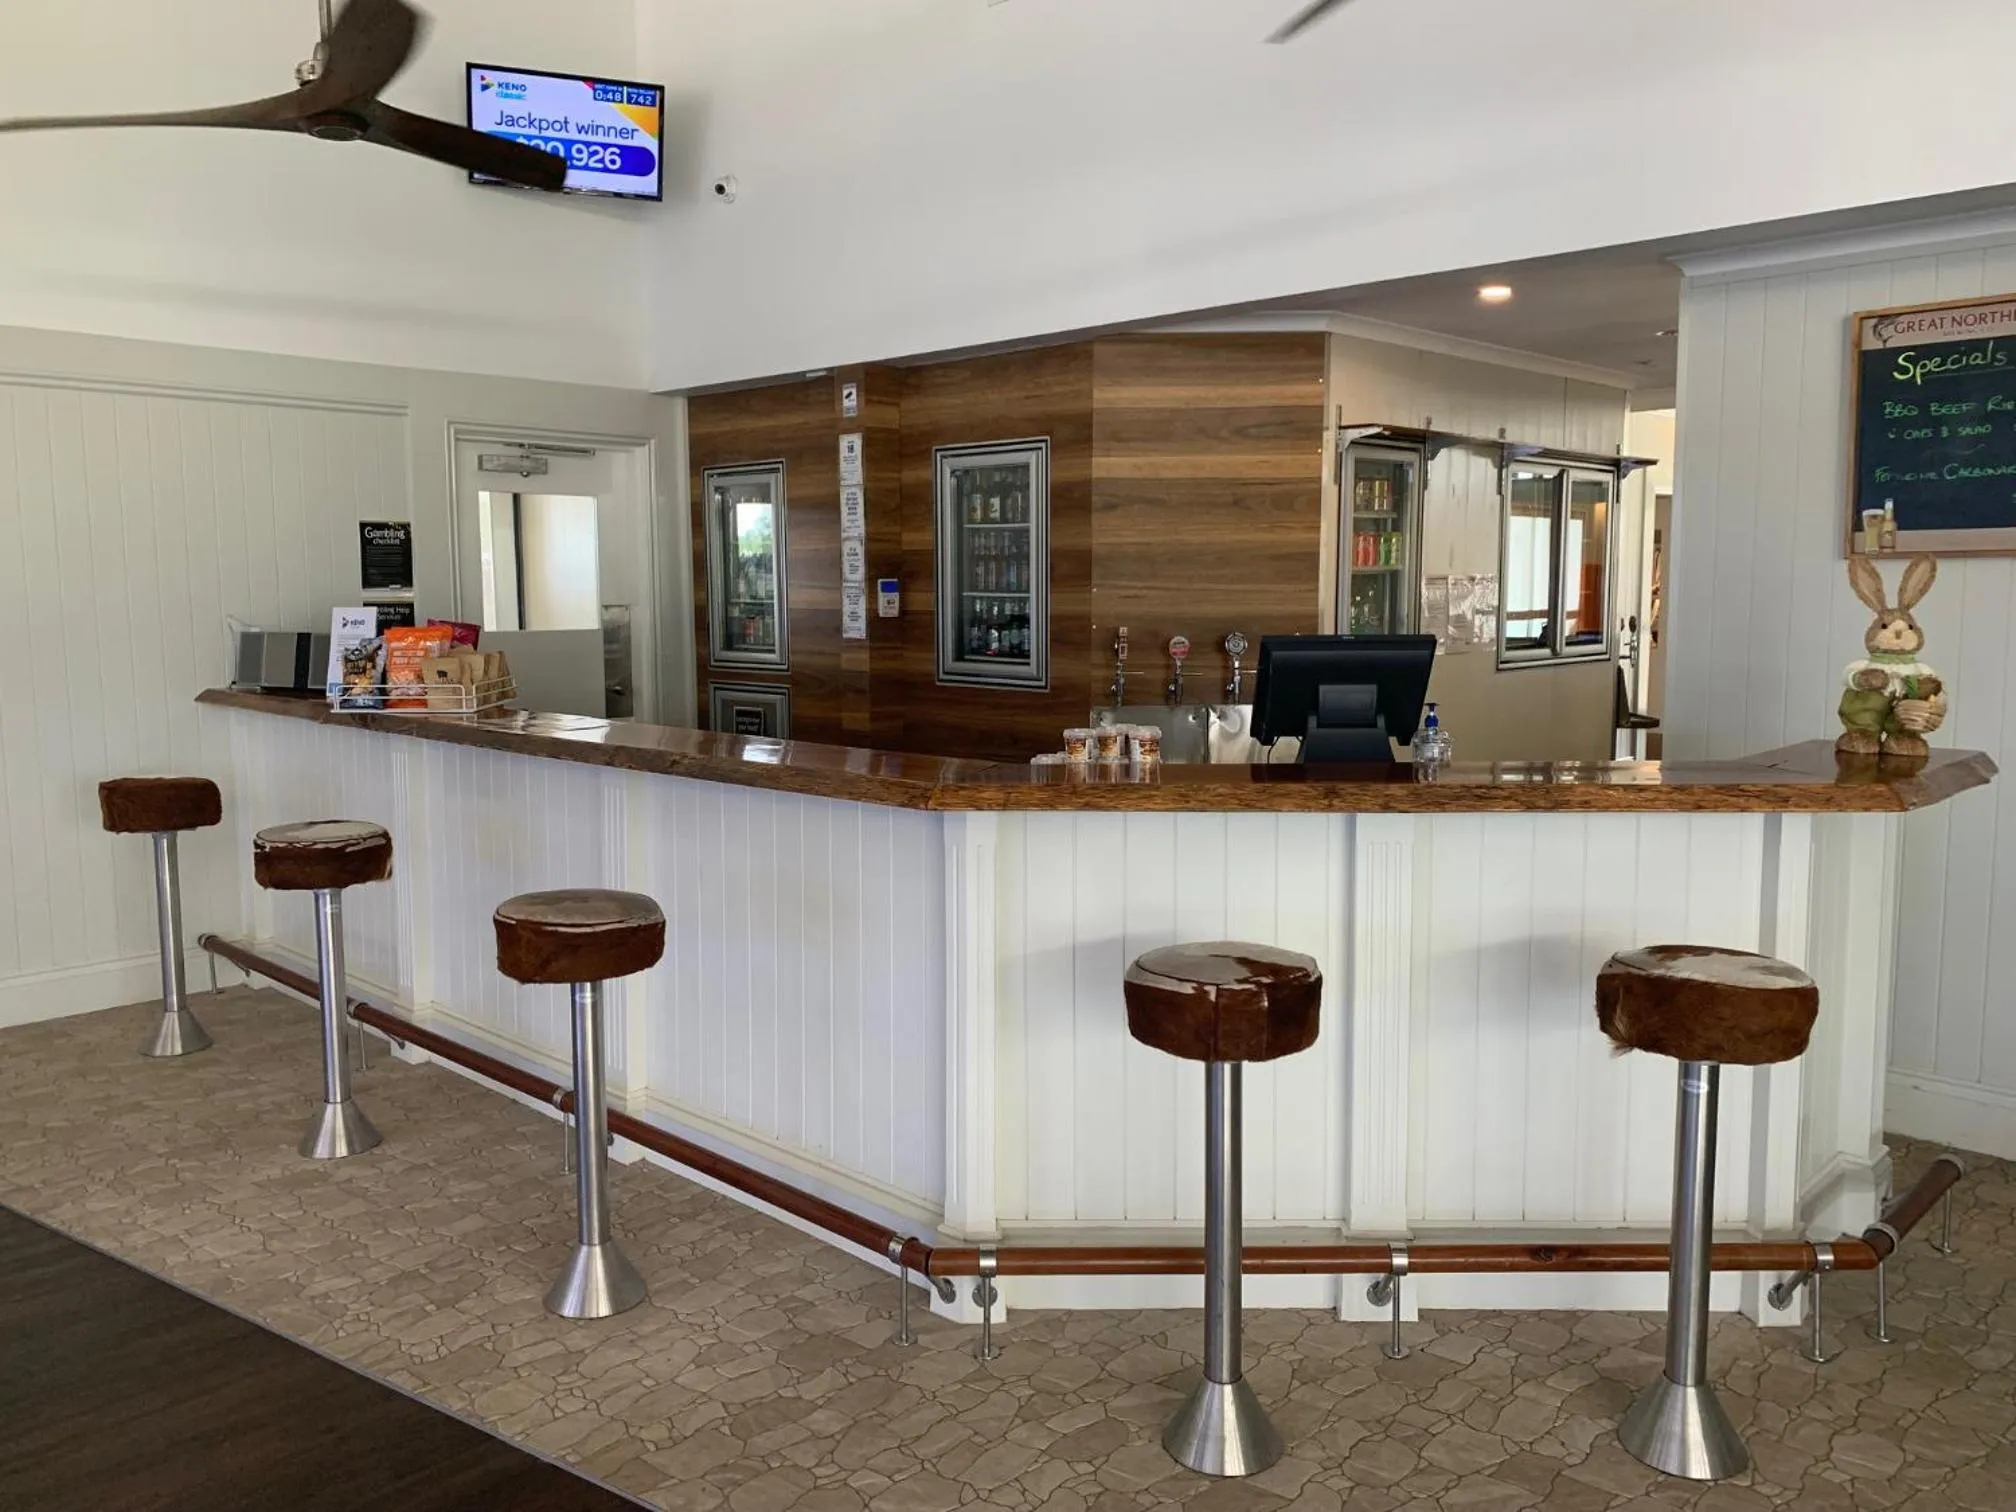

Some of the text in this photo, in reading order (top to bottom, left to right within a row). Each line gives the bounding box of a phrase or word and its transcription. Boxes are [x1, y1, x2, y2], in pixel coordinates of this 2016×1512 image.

[497, 82, 527, 92] KENO
[630, 94, 653, 105] 742
[494, 110, 641, 140] Jackpot winner
[1894, 317, 1947, 335] GREAT
[1892, 340, 2009, 385] Specials
[1882, 401, 1919, 419] BBQ
[1929, 402, 1979, 416] BEEF
[365, 526, 406, 540] Gambling
